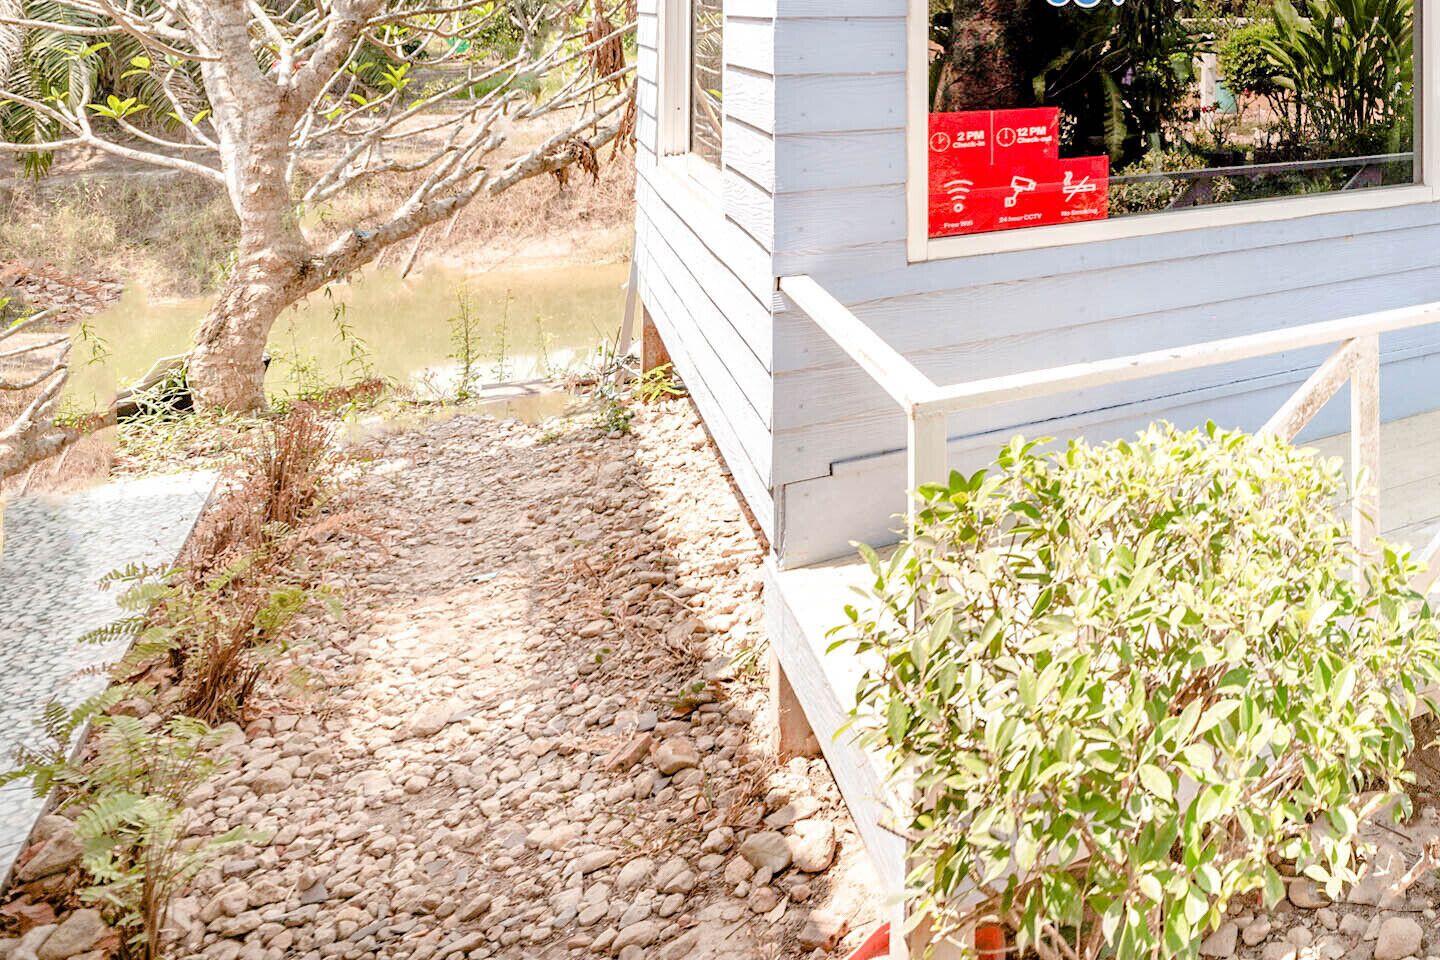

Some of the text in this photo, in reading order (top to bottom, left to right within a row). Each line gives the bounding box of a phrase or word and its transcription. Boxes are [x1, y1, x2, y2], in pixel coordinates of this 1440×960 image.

[957, 131, 984, 141] 2 PM
[1016, 126, 1047, 136] 12 PM
[1023, 213, 1042, 221] CCTV
